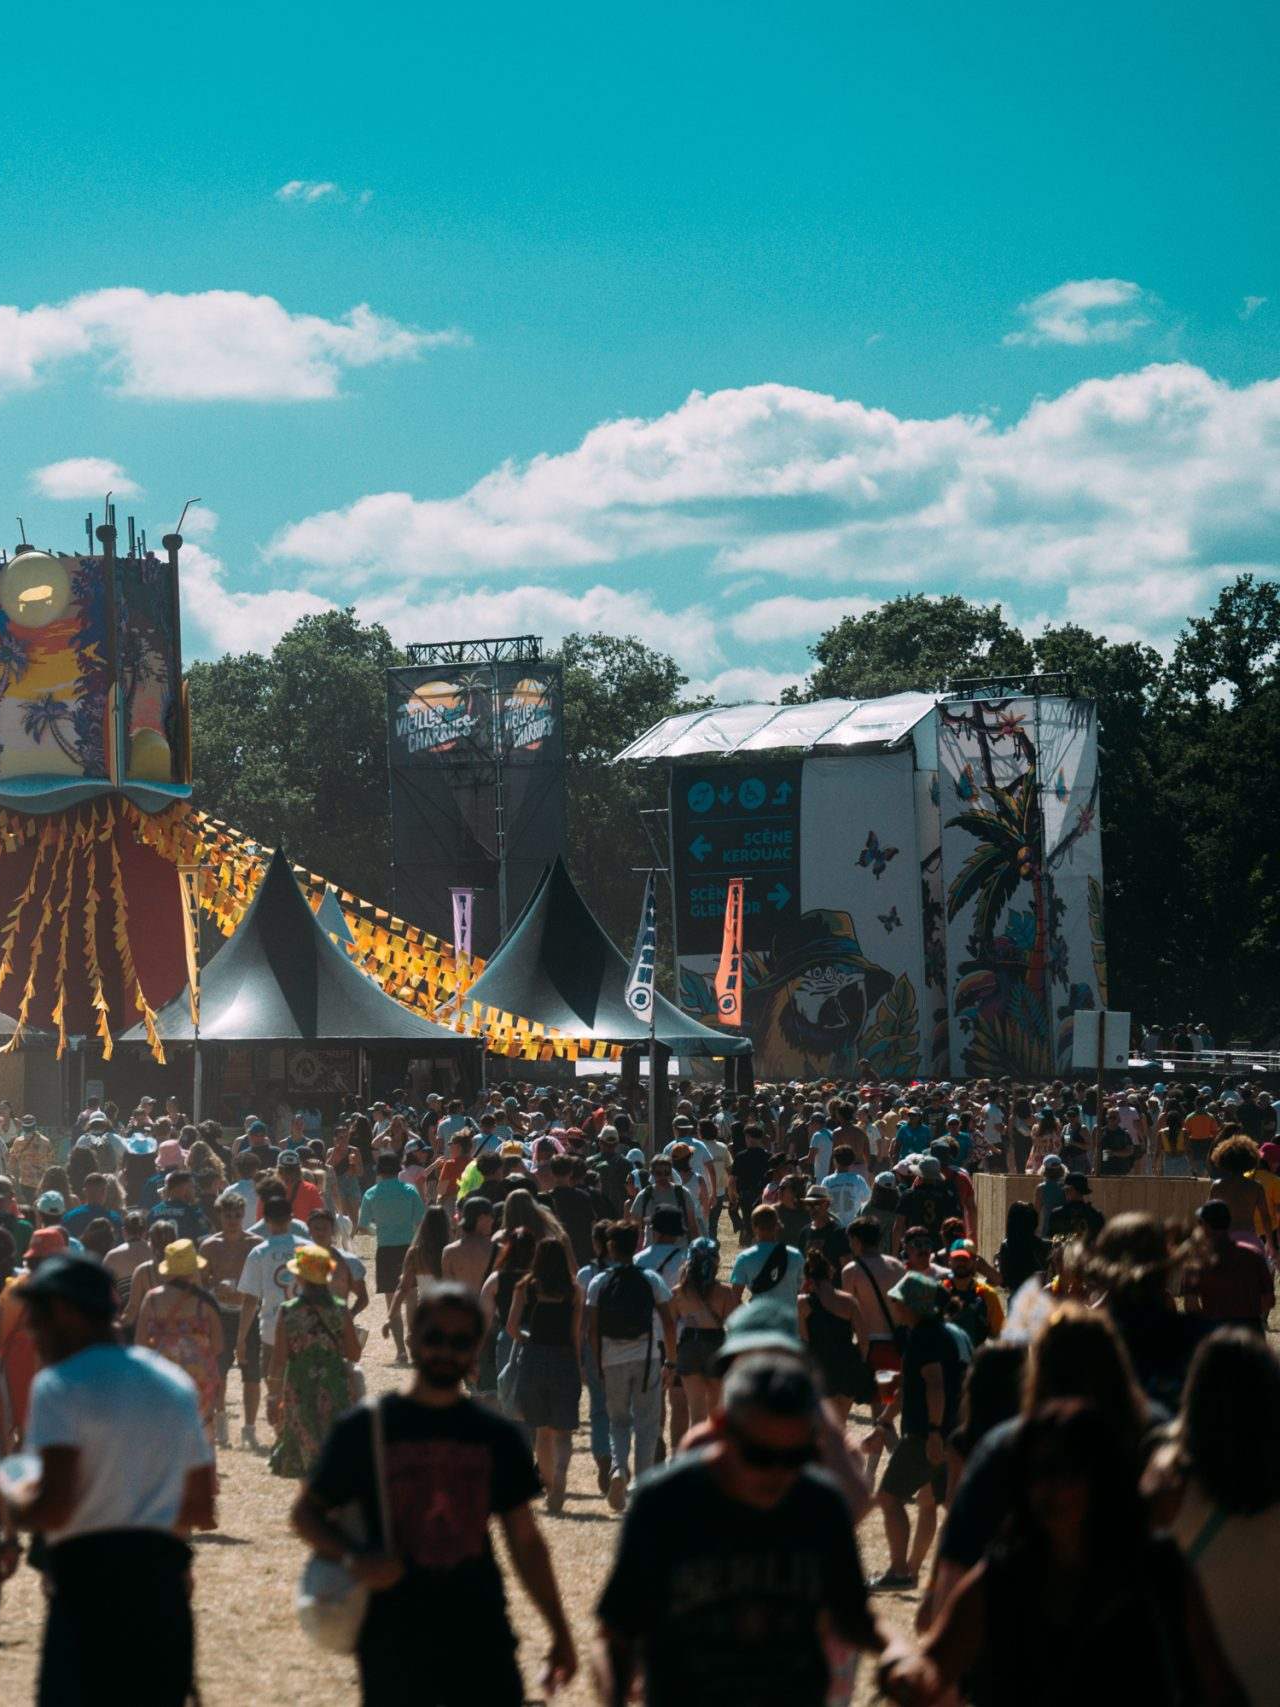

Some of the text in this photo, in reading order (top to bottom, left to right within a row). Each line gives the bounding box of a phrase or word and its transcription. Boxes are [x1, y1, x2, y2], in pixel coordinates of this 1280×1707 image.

[396, 704, 447, 737] VIEILLES
[504, 702, 537, 731] VIEILLES
[408, 714, 478, 753] CHARRUES
[513, 714, 555, 749] CHARRUES
[744, 828, 793, 846] SCÈNE
[722, 846, 793, 863] KEROUAC
[690, 884, 728, 902] SCÈN
[690, 901, 761, 918] GLENOR
